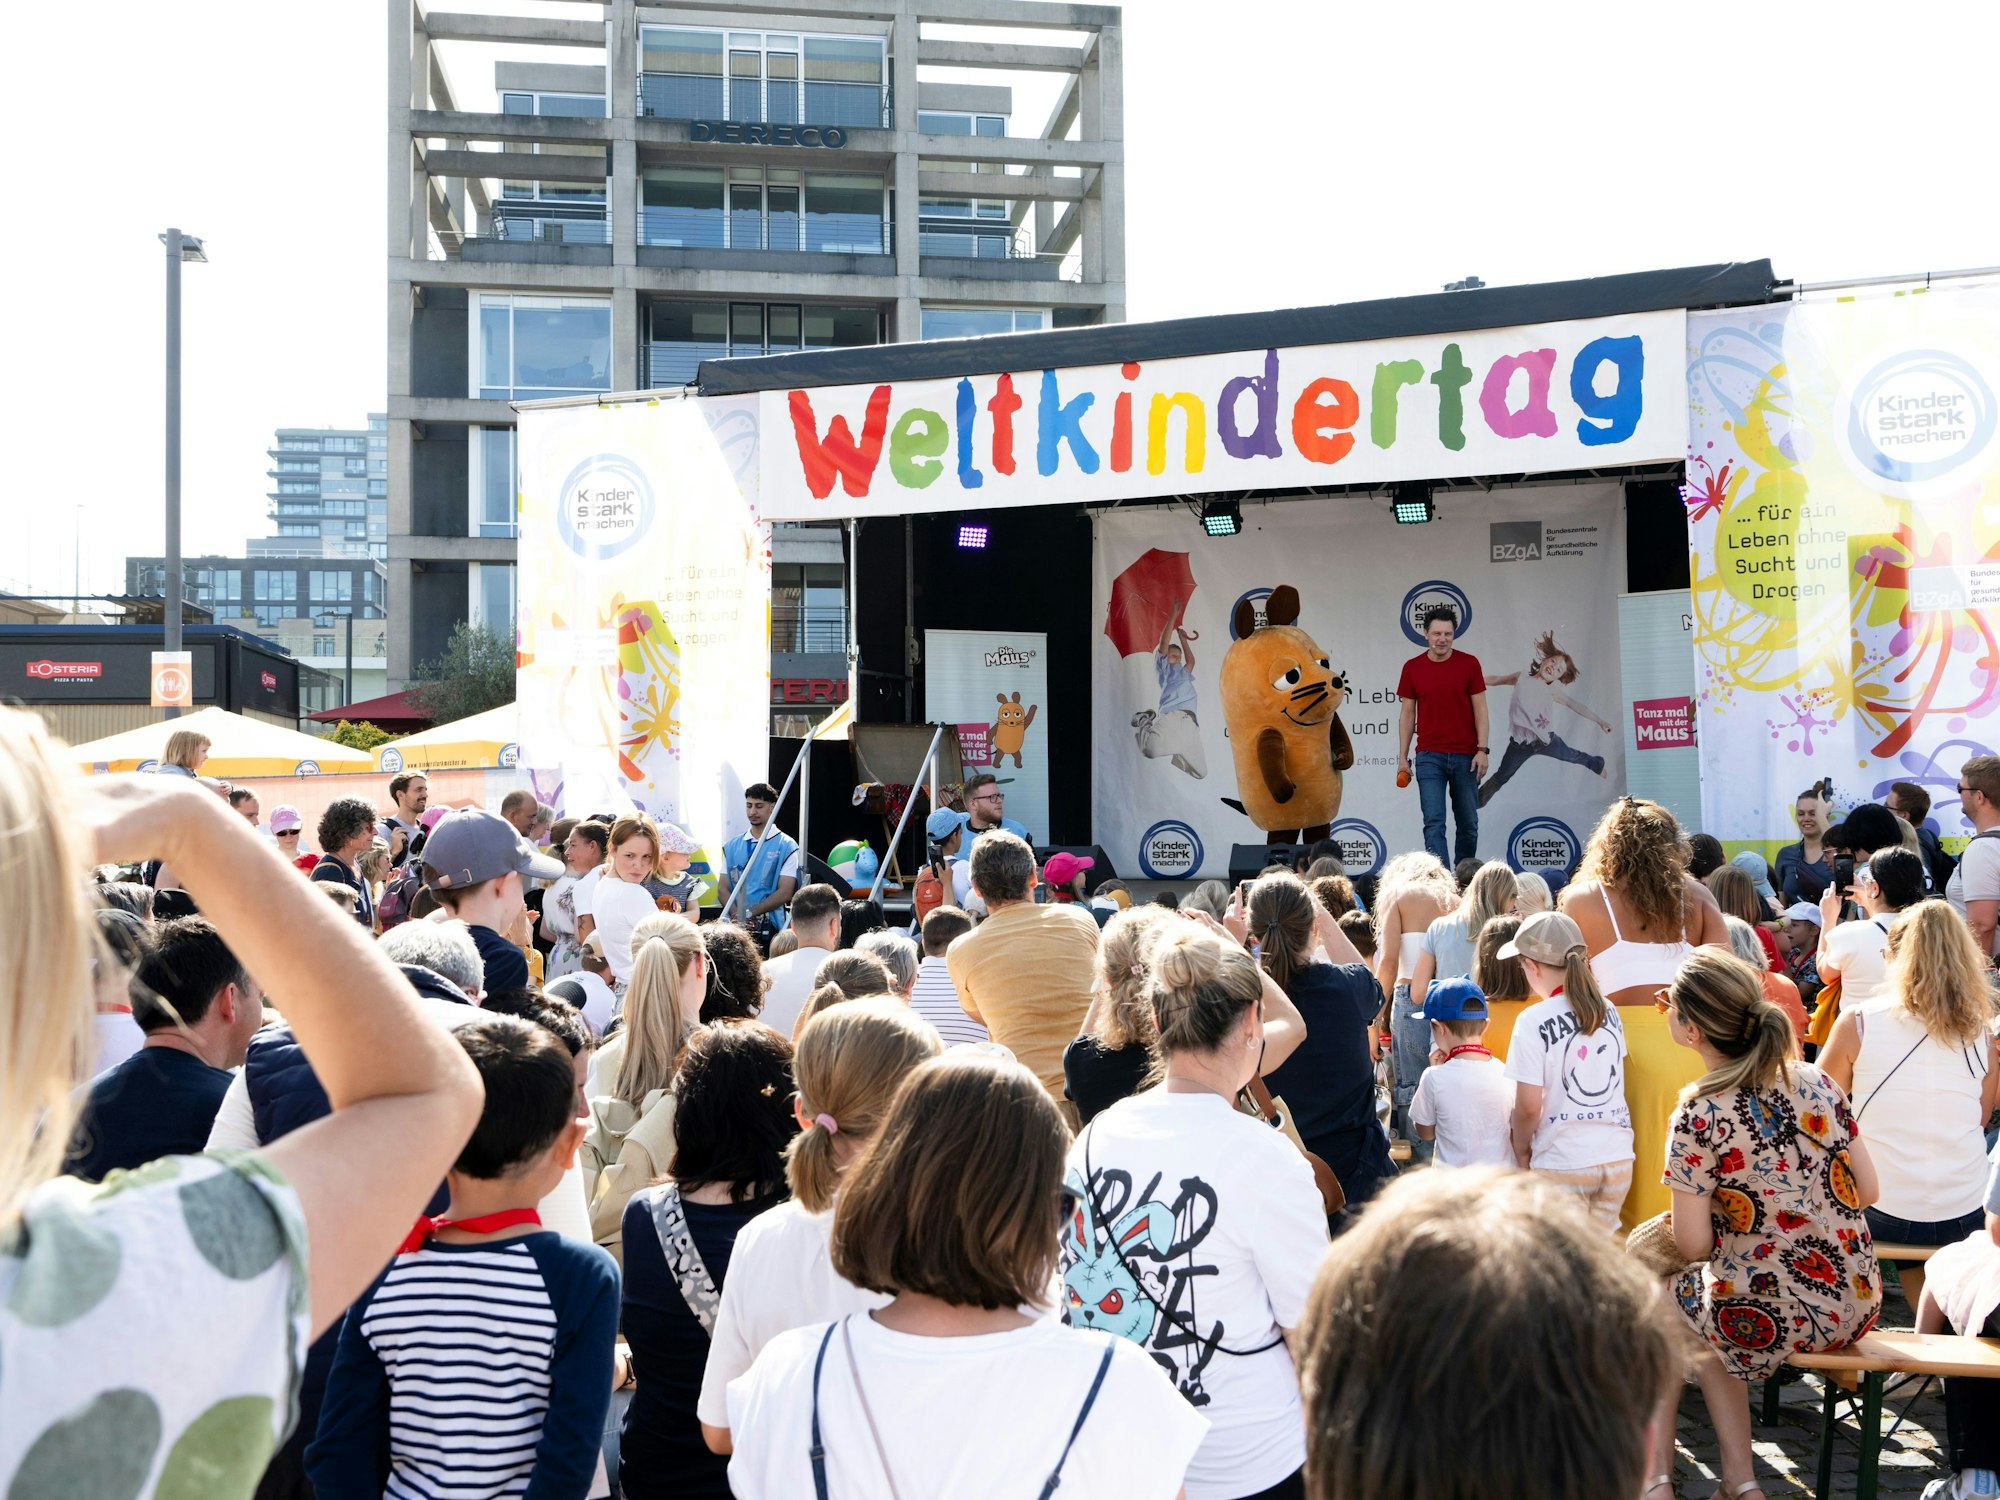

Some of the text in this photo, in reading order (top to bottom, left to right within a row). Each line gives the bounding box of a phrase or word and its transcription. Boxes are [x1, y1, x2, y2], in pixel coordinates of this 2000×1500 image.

[690, 120, 847, 149] DERECO
[1878, 391, 1965, 413] Kinder
[787, 333, 1645, 500] Weltkindertag
[1879, 408, 1966, 430] stark
[1880, 429, 1966, 446] machen
[578, 488, 635, 503] Kinder
[577, 502, 634, 517] stark
[1758, 504, 1792, 521] für
[1801, 501, 1836, 518] ein
[577, 517, 634, 530] machen
[1546, 526, 1598, 535] Bundeszentrale
[1728, 527, 1846, 549] Leben ohne
[1493, 542, 1540, 562] BZgA
[1546, 541, 1598, 550] gesundheitliche
[1546, 549, 1583, 557] Aufklärung
[1736, 552, 1841, 574] Sucht und
[1753, 584, 1825, 601] Drogen
[997, 646, 1014, 656] Die
[984, 651, 1030, 667] Maus
[30, 663, 98, 676] L'OSTERIA
[1359, 687, 1403, 704] Leb
[1636, 705, 1688, 719] Tanz mal
[1352, 718, 1389, 735] und
[1659, 718, 1689, 727] mit der
[966, 730, 987, 741] mal
[1637, 725, 1690, 742] Maus
[974, 740, 987, 748] der
[1152, 841, 1190, 850] Kinder
[1522, 839, 1566, 848] Kinder
[1152, 850, 1190, 859] stark
[1522, 848, 1566, 858] stark
[1152, 859, 1190, 867] machen
[1522, 858, 1566, 866] machen
[1577, 1111, 1603, 1120] GOT
